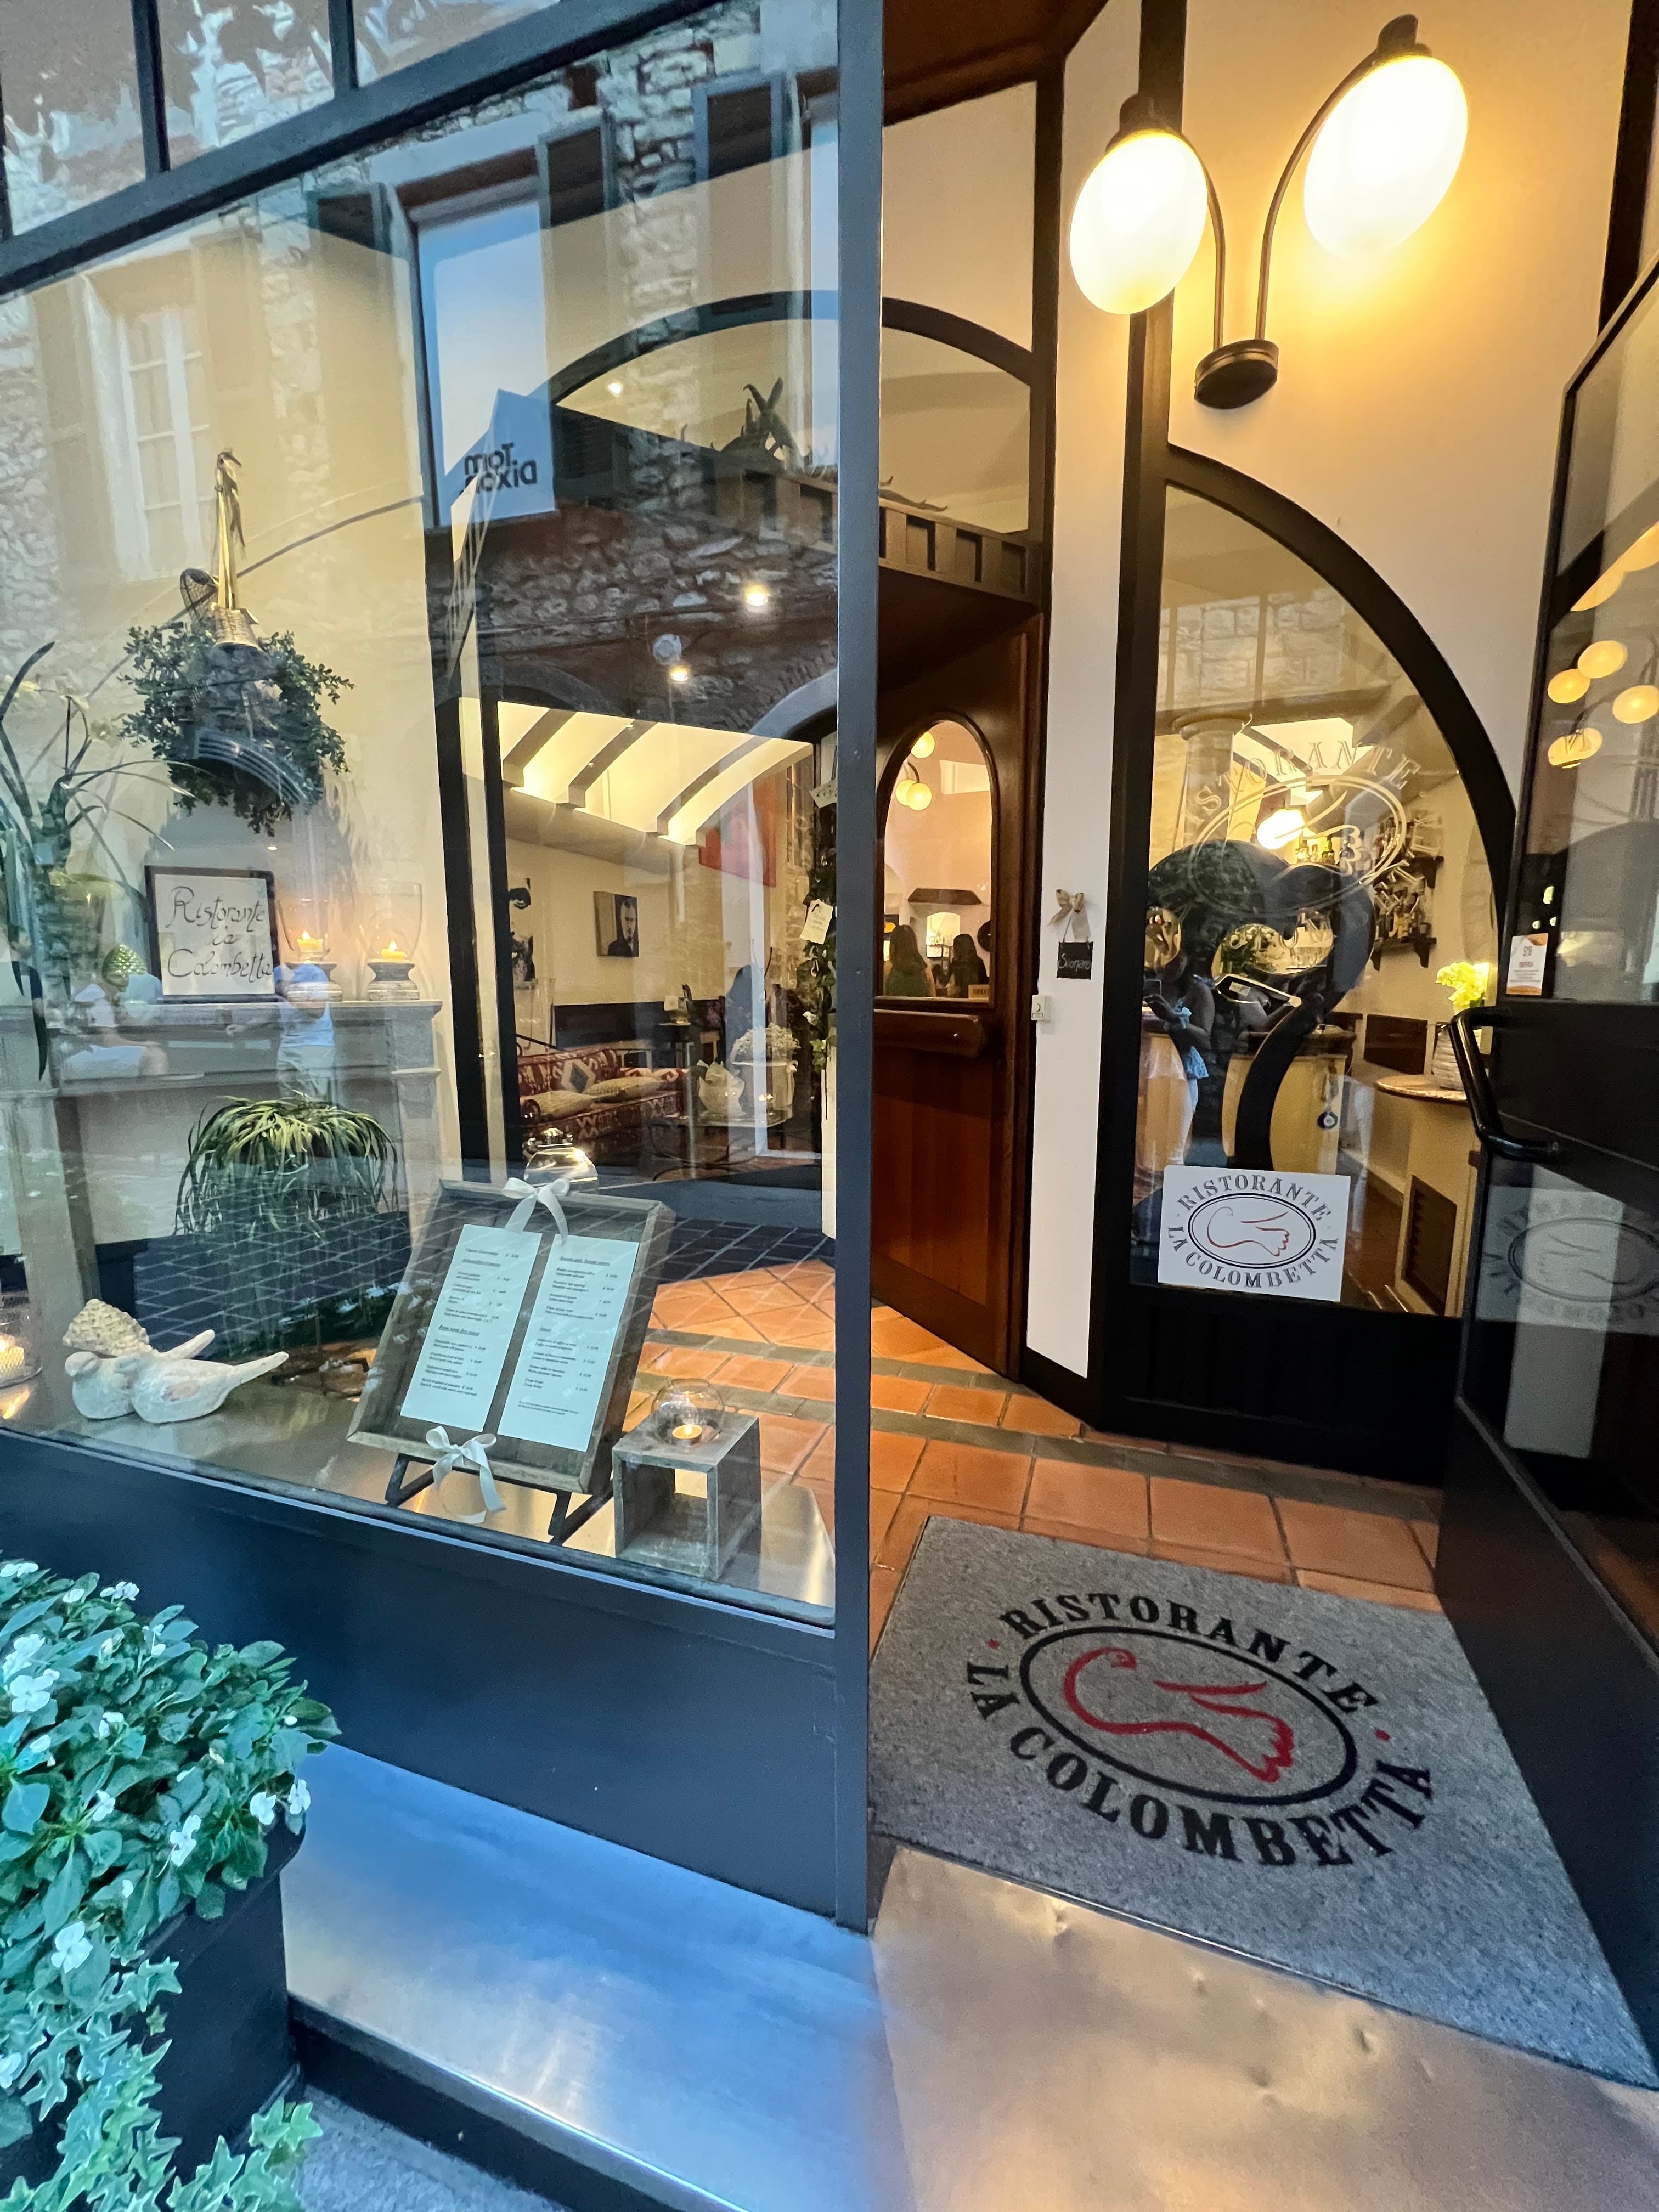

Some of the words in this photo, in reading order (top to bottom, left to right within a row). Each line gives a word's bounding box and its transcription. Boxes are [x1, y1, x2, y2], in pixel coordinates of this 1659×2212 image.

[1174, 740, 1421, 845] ISTORANTE
[165, 886, 265, 933] Ristorante
[168, 948, 272, 983] Colombetta
[1177, 1174, 1331, 1221] RISTORANTE
[1168, 1226, 1188, 1252] LA
[1186, 1238, 1339, 1288] COLOMBETTA
[999, 1592, 1379, 1715] RISTORANTE
[967, 1661, 1019, 1720] LA
[1009, 1726, 1433, 1866] COLOMBETTA
